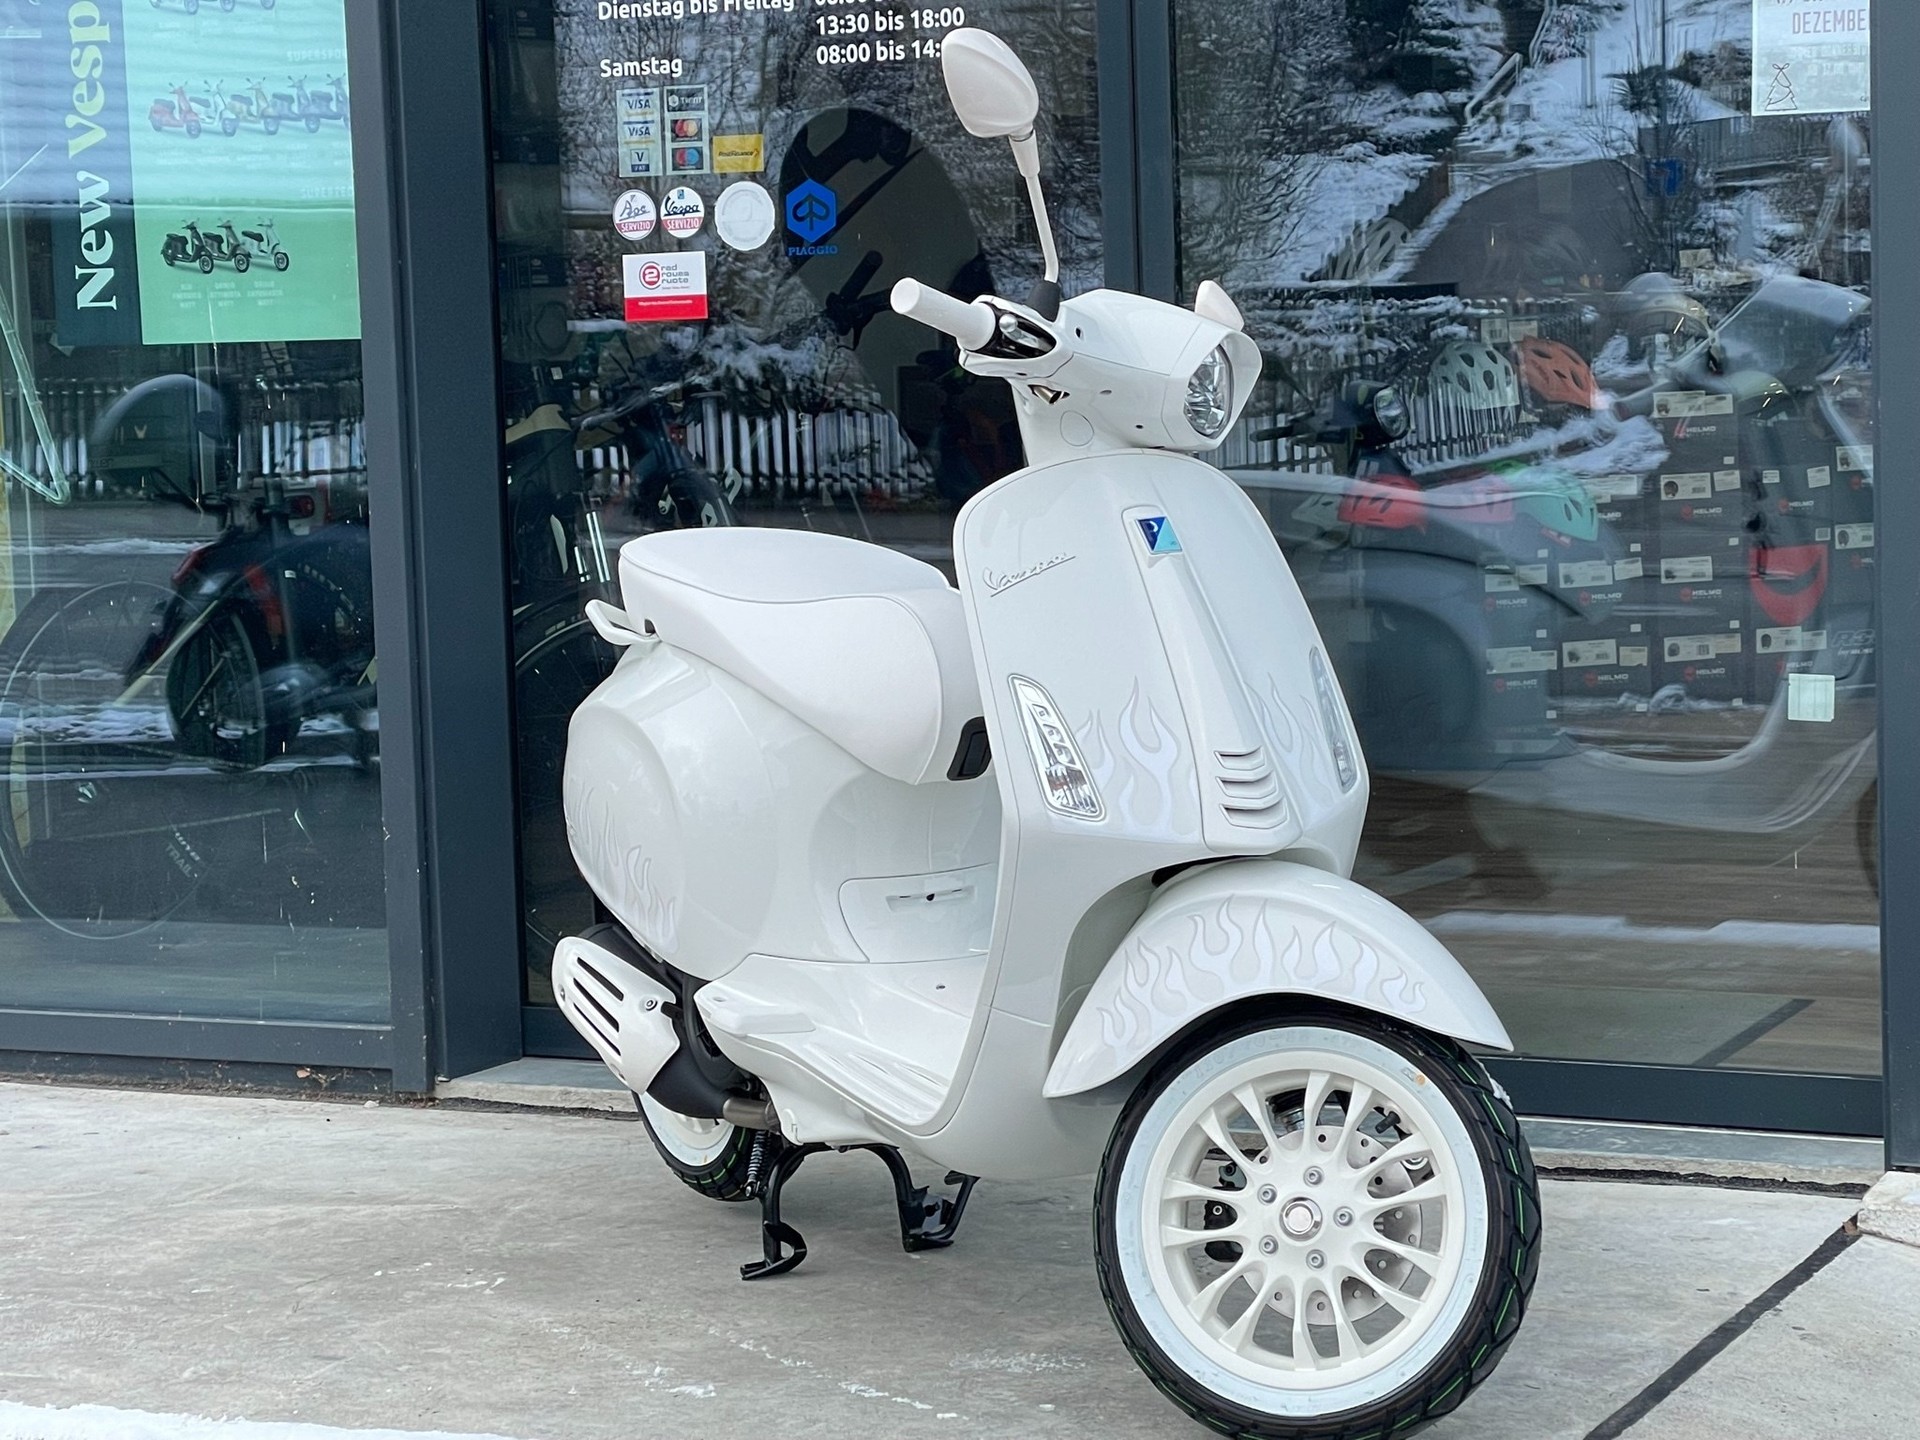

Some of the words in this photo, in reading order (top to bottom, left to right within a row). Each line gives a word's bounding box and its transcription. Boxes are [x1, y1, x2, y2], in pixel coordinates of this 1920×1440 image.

[598, 0, 684, 20] Dienstag
[690, 0, 718, 14] bis
[815, 13, 870, 36] 13:30
[875, 10, 905, 32] bis
[910, 7, 965, 29] 18:00
[1792, 9, 1868, 34] DEZEMBE
[816, 43, 871, 65] 08:00
[876, 40, 905, 61] bis
[911, 39, 941, 59] 14:
[600, 57, 683, 77] Samstag
[627, 98, 651, 109] VISA
[628, 126, 651, 137] VISA
[663, 195, 701, 217] Vespa
[621, 221, 651, 232] SERVIZIO
[666, 217, 700, 230] SERVIZIO
[75, 170, 117, 311] New
[788, 245, 838, 257] PIAGGIO
